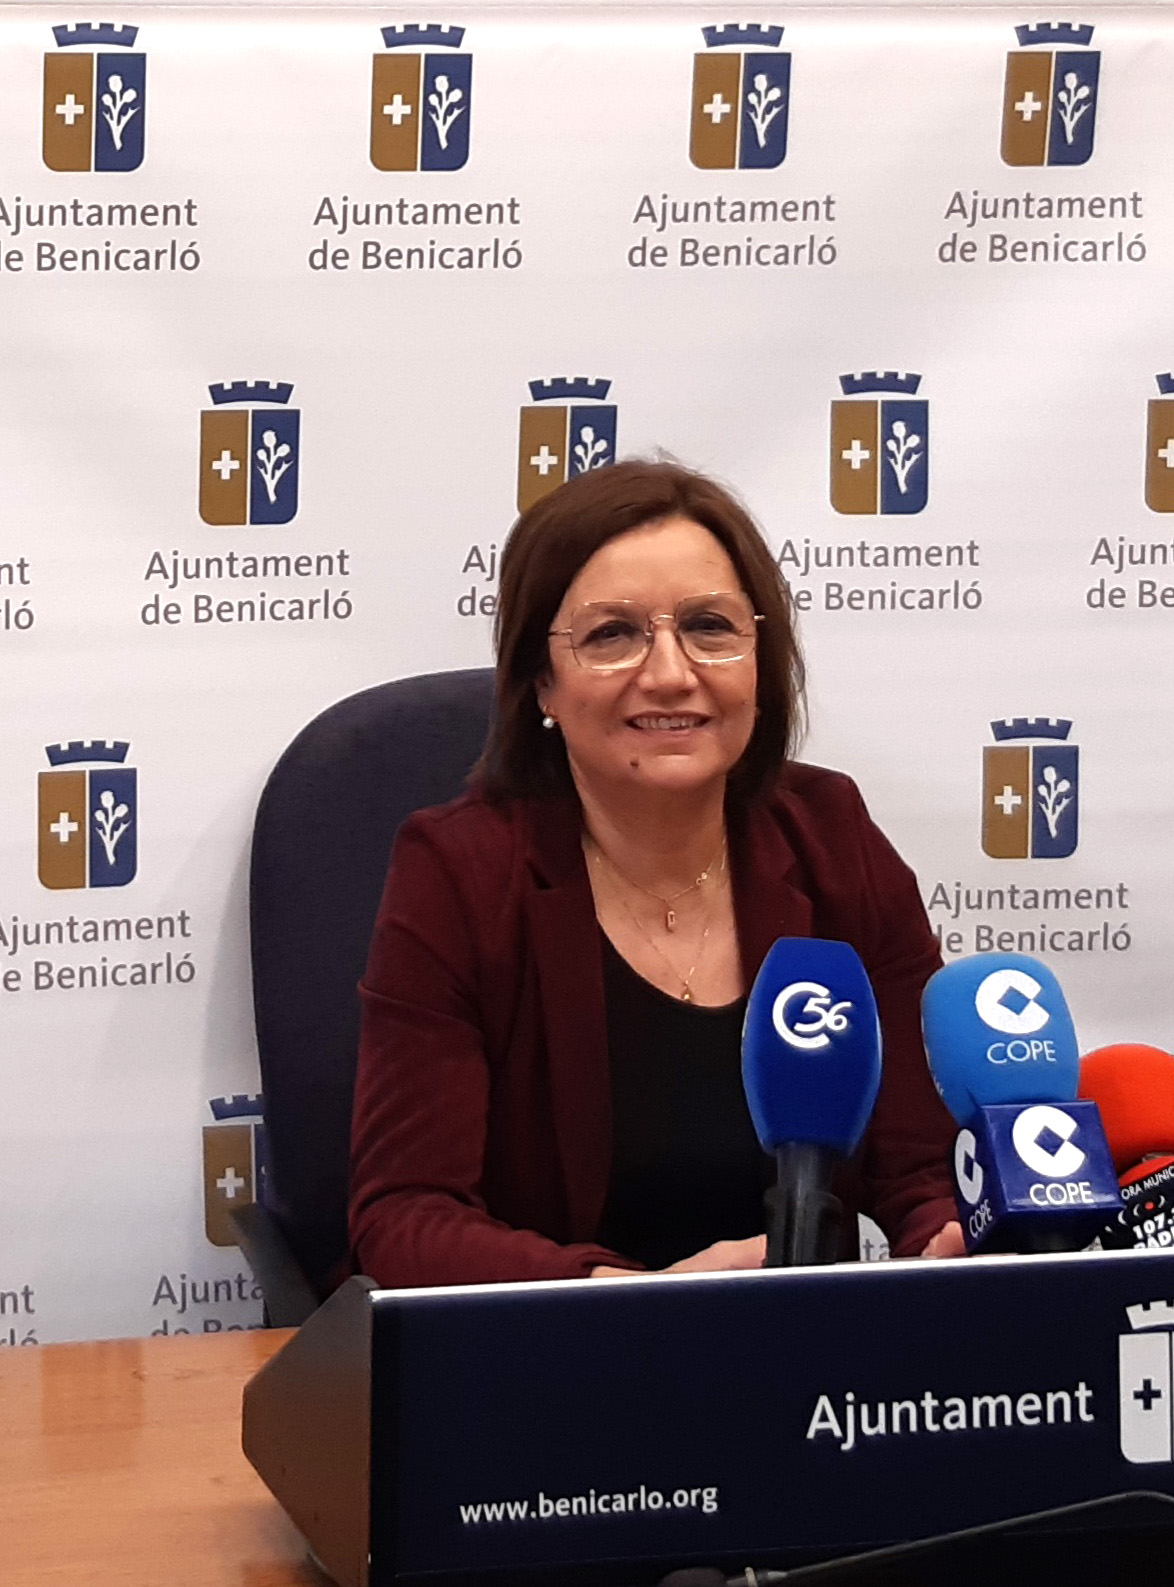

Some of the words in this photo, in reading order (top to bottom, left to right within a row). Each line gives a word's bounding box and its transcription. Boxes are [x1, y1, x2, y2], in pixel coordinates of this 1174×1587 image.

[314, 196, 520, 233] Ajuntament
[633, 194, 835, 232] Ajuntament
[944, 191, 1142, 228] Ajuntament
[0, 242, 23, 271] e
[37, 240, 200, 271] Benicarló
[309, 239, 349, 270] de
[363, 238, 522, 269] Benicarló
[628, 237, 668, 267] de
[681, 235, 836, 266] Benicarló
[939, 233, 977, 262] de
[989, 232, 1146, 262] Benicarló
[145, 550, 349, 585] Ajuntament
[779, 538, 979, 576] Ajuntament
[142, 588, 181, 625] de
[195, 589, 352, 623] Benicarló
[458, 586, 497, 616] de
[825, 580, 982, 610] Benicarló
[1087, 579, 1126, 608] de
[928, 882, 1128, 919] Ajuntament
[976, 922, 1131, 952] Benicarló
[3, 969, 21, 992] e
[35, 952, 195, 990] Benicarló
[986, 1040, 1057, 1064] COPE
[1029, 1182, 1094, 1206] COPE
[968, 1199, 993, 1239] COPE
[807, 1382, 1093, 1450] Ajuntament
[460, 1486, 717, 1523] www.benicarlo.org
